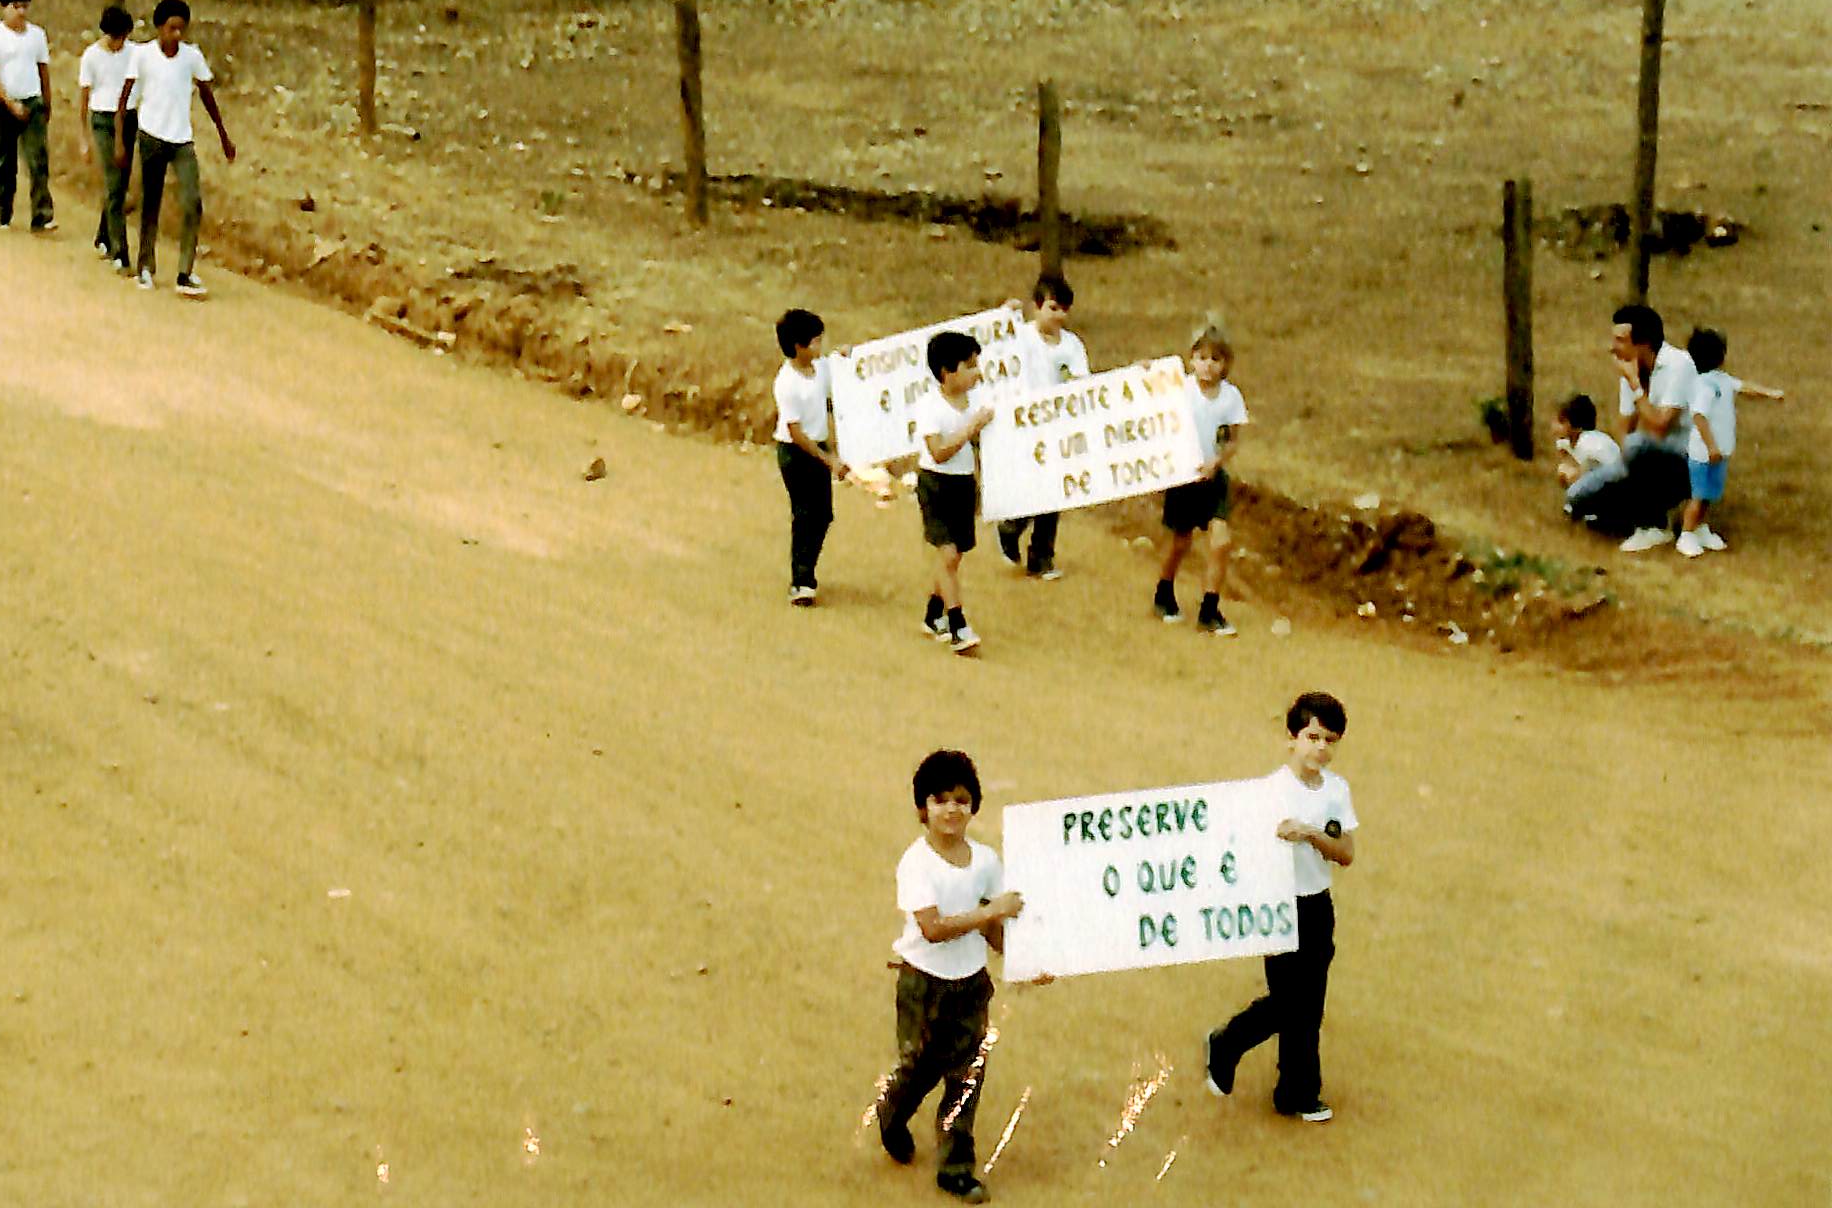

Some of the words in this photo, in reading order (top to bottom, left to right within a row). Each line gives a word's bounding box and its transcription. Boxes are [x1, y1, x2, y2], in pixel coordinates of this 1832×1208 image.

[1013, 384, 1111, 428] RESPEITE
[1122, 380, 1135, 403] A
[1103, 409, 1181, 449] DIREITO
[1062, 469, 1092, 498] DE
[1109, 451, 1176, 488] TODOS
[1063, 798, 1209, 844] PRESERVE
[1103, 864, 1121, 898] O
[1137, 854, 1198, 894] QUE
[1139, 912, 1179, 949] DE
[1199, 901, 1293, 941] TODOS
